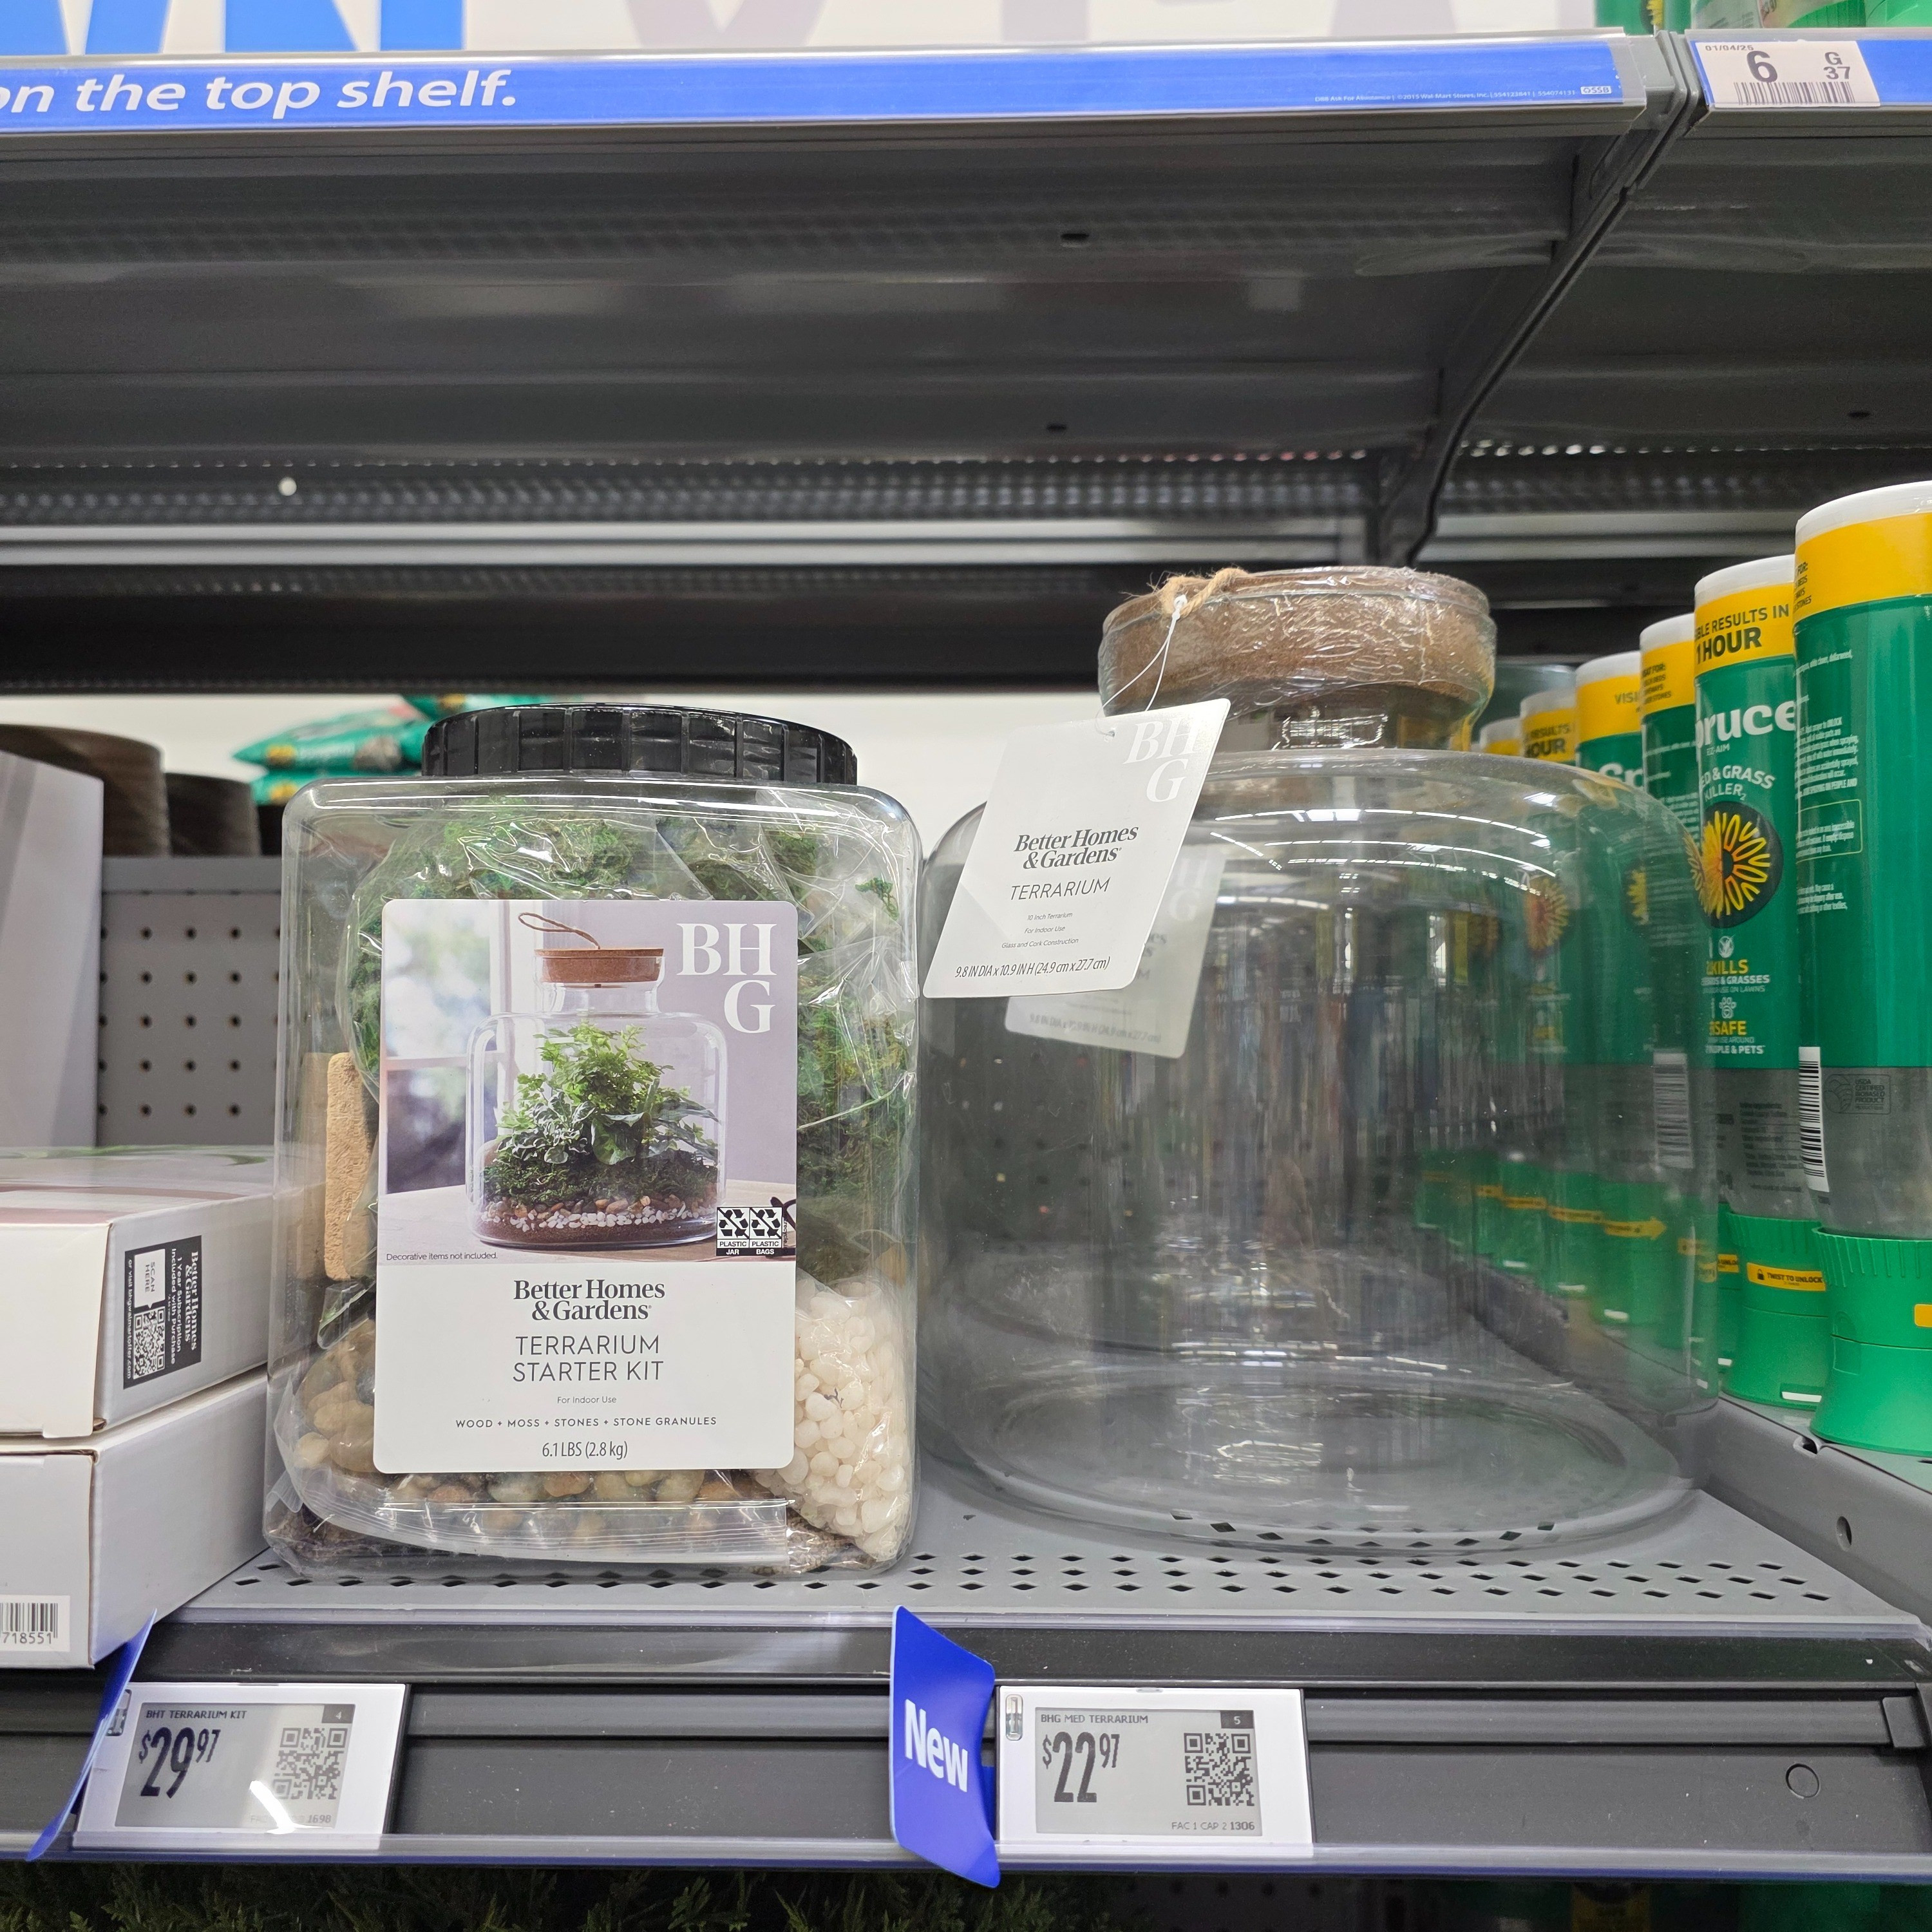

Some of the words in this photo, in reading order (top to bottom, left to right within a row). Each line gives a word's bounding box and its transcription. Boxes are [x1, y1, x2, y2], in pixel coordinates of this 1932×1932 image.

[1747, 50, 1778, 82] 6
[1824, 52, 1843, 65] G
[1823, 66, 1851, 80] 37
[75, 74, 187, 111] the
[206, 77, 320, 120] top
[337, 69, 517, 108] shelf.
[1712, 607, 1768, 634] RESULTS
[1772, 603, 1789, 619] IN
[1703, 627, 1763, 664] HOUR
[1122, 717, 1202, 764] BH
[1146, 758, 1189, 802] G
[1712, 767, 1721, 781] &
[1722, 764, 1776, 790] GRASS
[1014, 833, 1072, 852] Better
[1071, 826, 1139, 848] Homes
[1023, 851, 1039, 869] &
[1040, 847, 1119, 868] Gardens
[1010, 876, 1111, 900] TERRARIUM
[676, 923, 777, 976] BH
[1043, 937, 1079, 946] Construction
[954, 966, 969, 978] 9.8
[978, 965, 994, 977] DIA
[999, 963, 1017, 976] 10.9
[1075, 958, 1094, 972] 27.7
[1727, 974, 1770, 985] GRASSES
[724, 980, 776, 1034] G
[386, 1253, 427, 1261] Decorative
[464, 1251, 498, 1260] included.
[1785, 1273, 1795, 1282] TO
[1795, 1274, 1823, 1283] UNLOCK
[513, 1280, 582, 1300] Better
[585, 1279, 666, 1299] Homes
[531, 1300, 551, 1321] &
[553, 1300, 649, 1321] Gardens
[515, 1334, 659, 1356] TERRARIUM
[513, 1361, 618, 1382] STARTER
[627, 1361, 664, 1381] KIT
[557, 1396, 571, 1404] For
[572, 1396, 600, 1404] Indoor
[601, 1396, 618, 1404] Use
[455, 1419, 493, 1428] WOOD
[507, 1419, 540, 1428] MOSS
[554, 1418, 600, 1427] STONES
[613, 1417, 652, 1426] STONE
[655, 1416, 717, 1426] GRANULES
[542, 1442, 558, 1457] 6.1
[561, 1442, 582, 1457] LBS
[585, 1441, 608, 1459] (2.8
[610, 1441, 629, 1461] kg)
[2, 1631, 52, 1644] 718551
[146, 1710, 166, 1718] BHT
[169, 1710, 228, 1719] TERRARIUM
[230, 1710, 248, 1719] KIT
[336, 1710, 343, 1720] 4
[1041, 1714, 1061, 1723] BHG
[1064, 1714, 1086, 1723] MED
[1088, 1714, 1149, 1723] TERRARIUM
[1233, 1716, 1241, 1725] 5
[905, 1698, 969, 1793] New
[308, 1814, 332, 1823] 1698
[1171, 1821, 1191, 1830] FAC
[1200, 1821, 1219, 1830] CAP
[1222, 1822, 1227, 1830] 2
[1230, 1821, 1255, 1830] 1306
